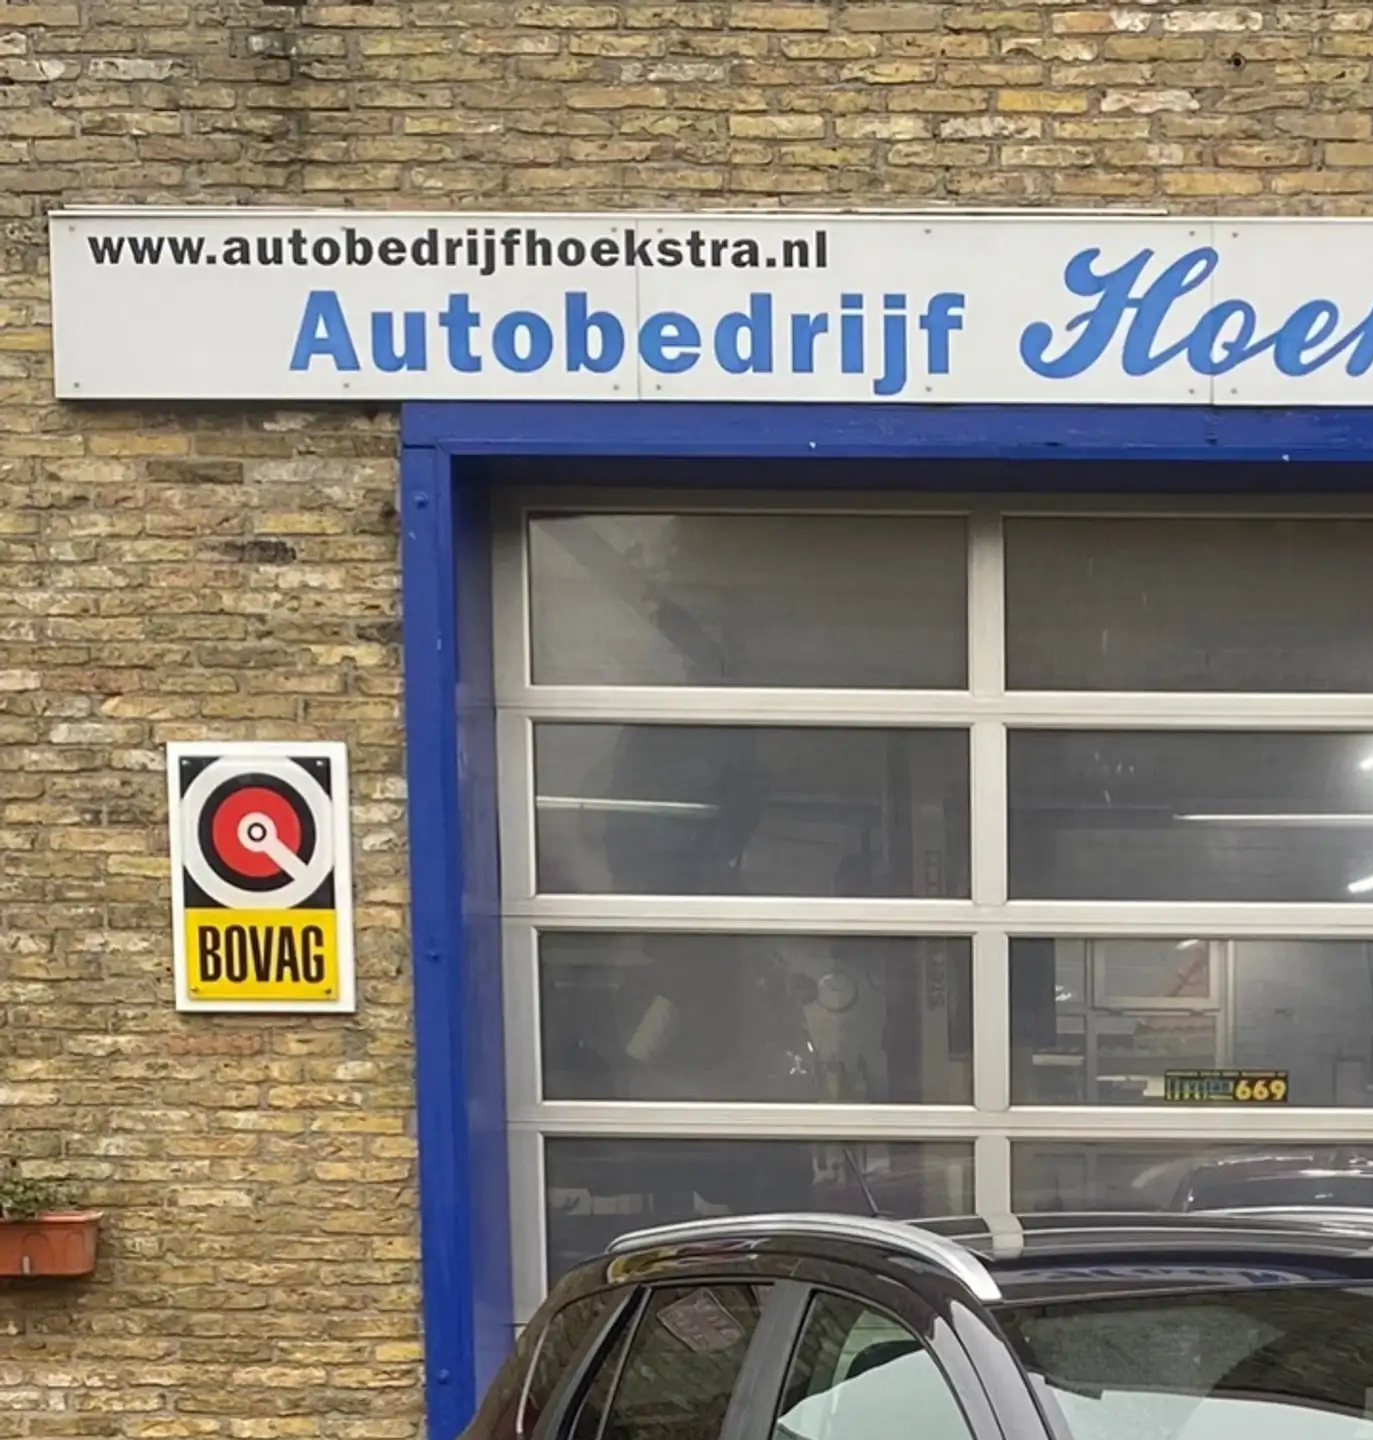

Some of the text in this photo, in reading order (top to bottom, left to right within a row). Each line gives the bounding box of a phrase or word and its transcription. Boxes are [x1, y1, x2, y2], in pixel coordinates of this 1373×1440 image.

[88, 229, 829, 275] www.autobedrijfhoekstra.nl
[289, 289, 965, 397] Autobedrijf
[197, 924, 326, 984] BOVAG
[1235, 1080, 1287, 1100] 669
